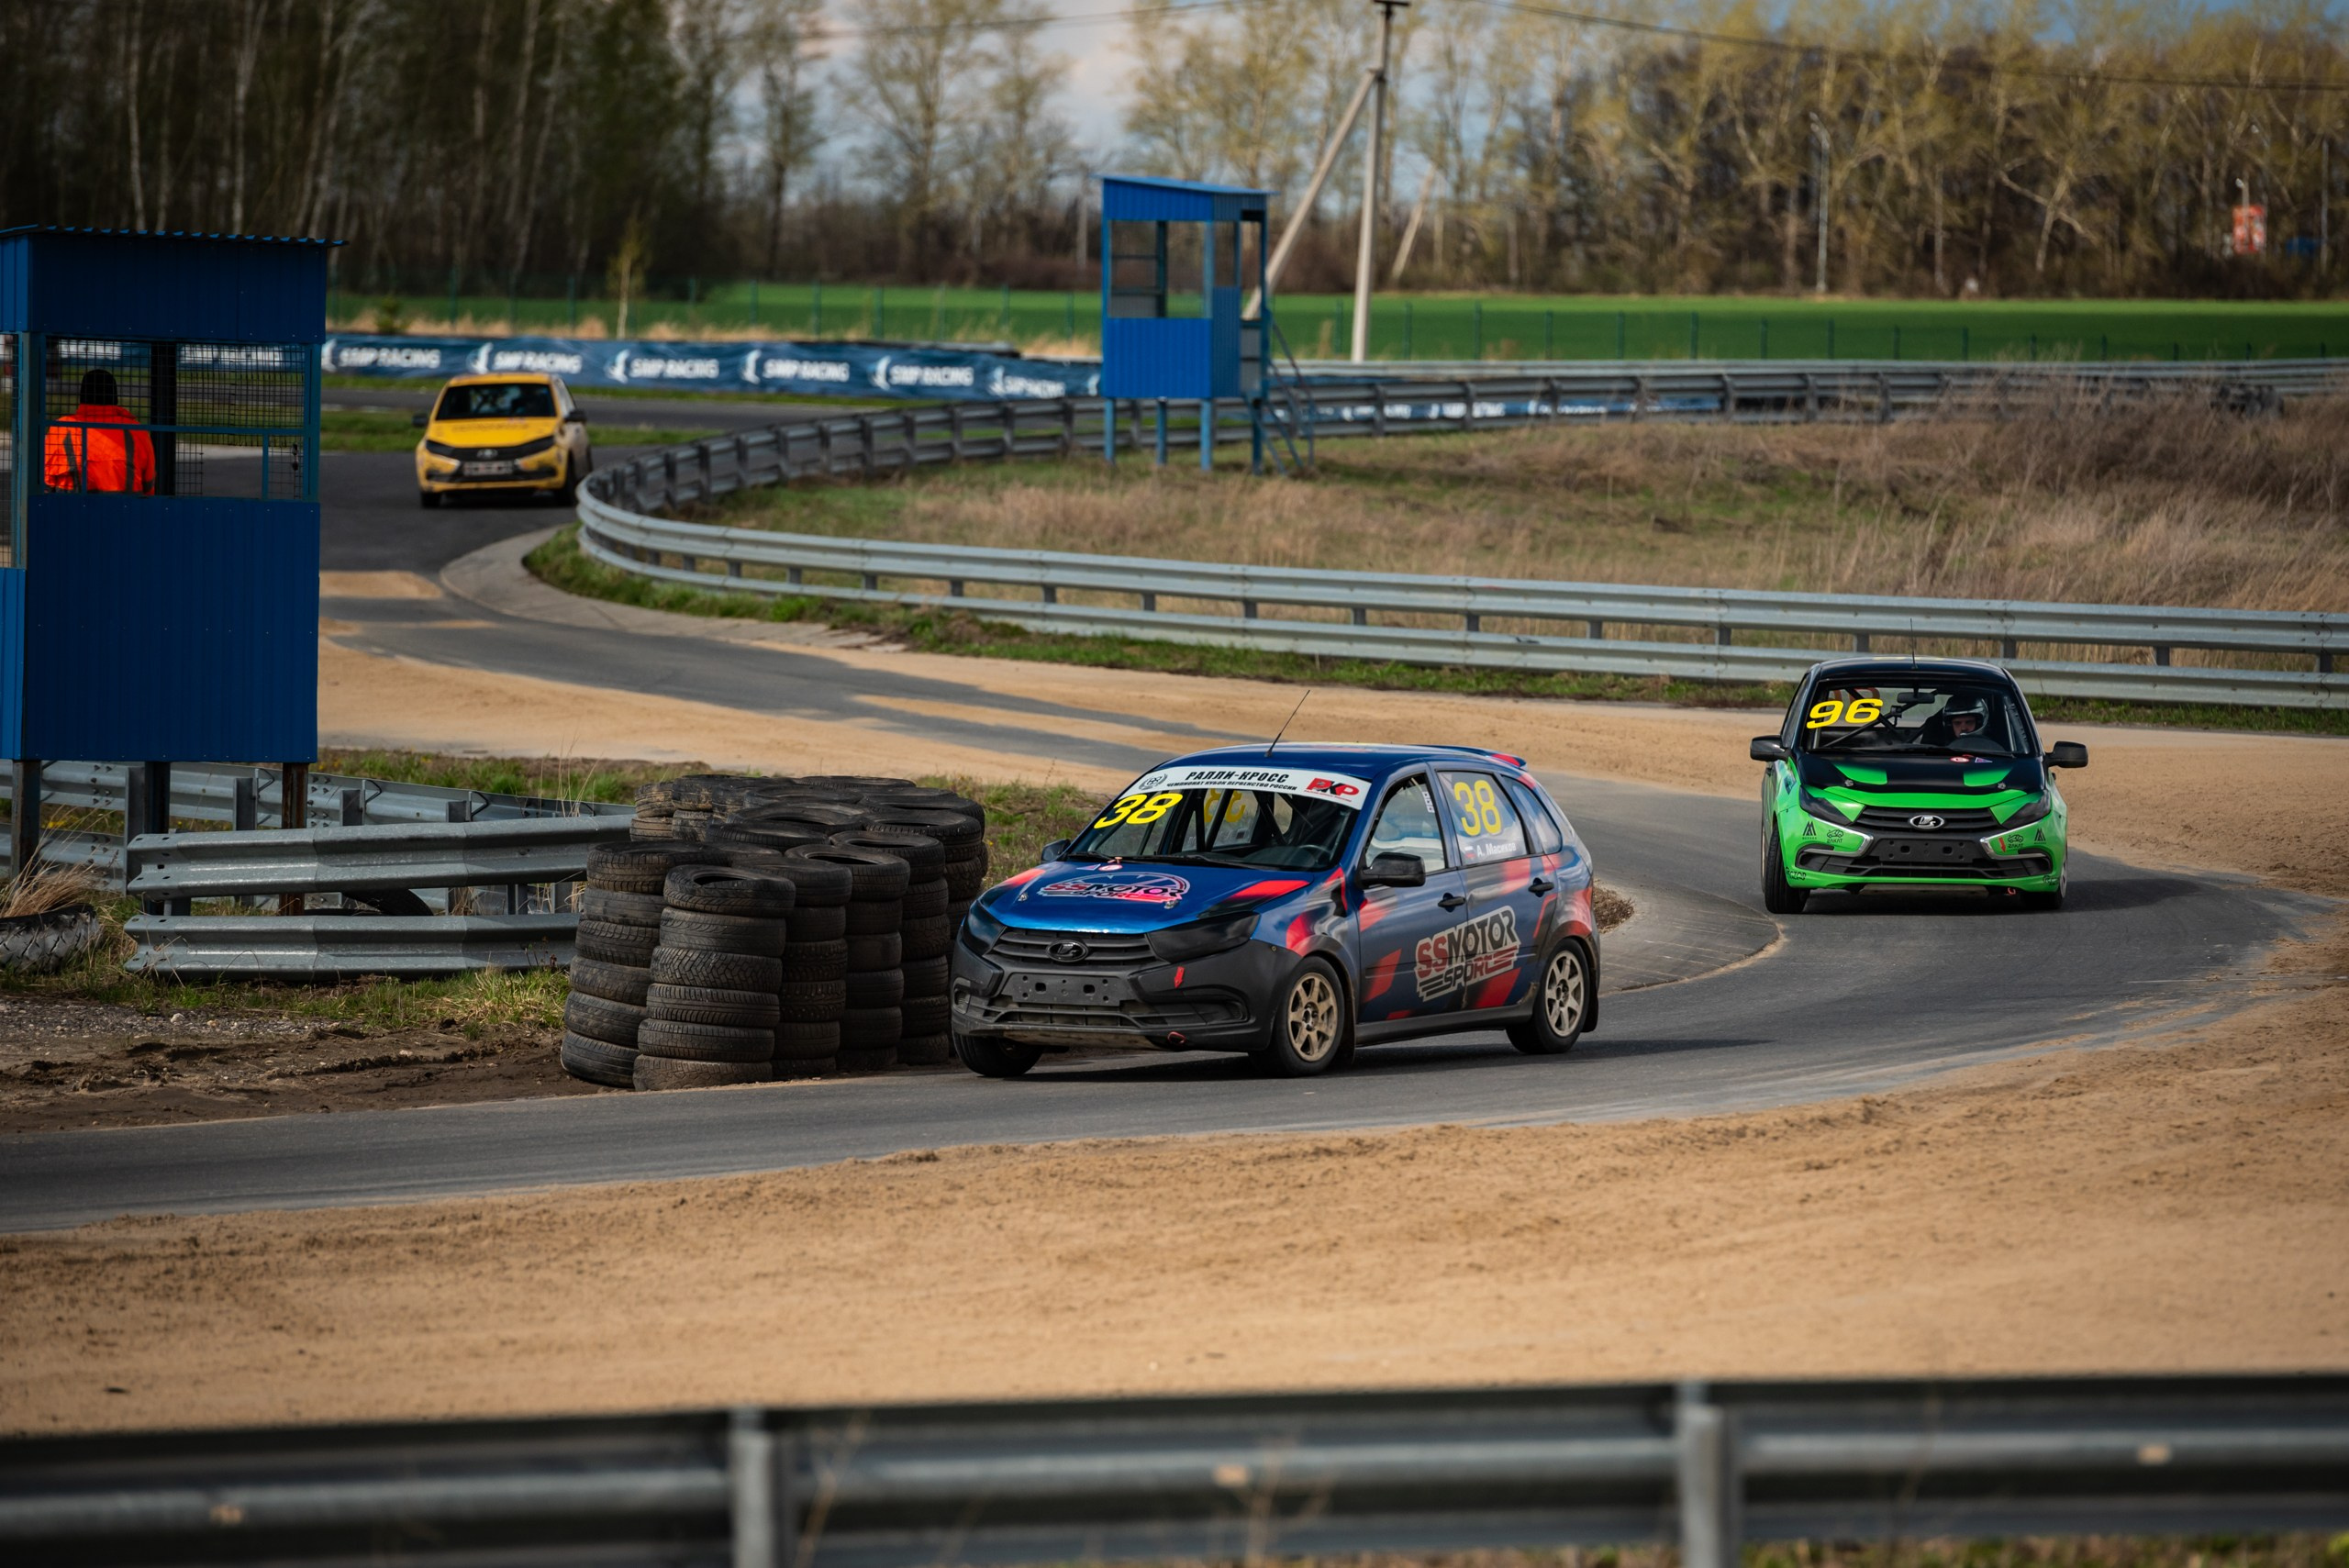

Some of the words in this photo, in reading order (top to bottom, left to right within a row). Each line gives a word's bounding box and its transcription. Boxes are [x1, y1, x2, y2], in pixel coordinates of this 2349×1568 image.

[1807, 698, 1884, 729] 96
[1185, 771, 1289, 783] РАЛЛИ-КРОСС
[1094, 793, 1183, 828] 38
[1453, 780, 1501, 836] 38
